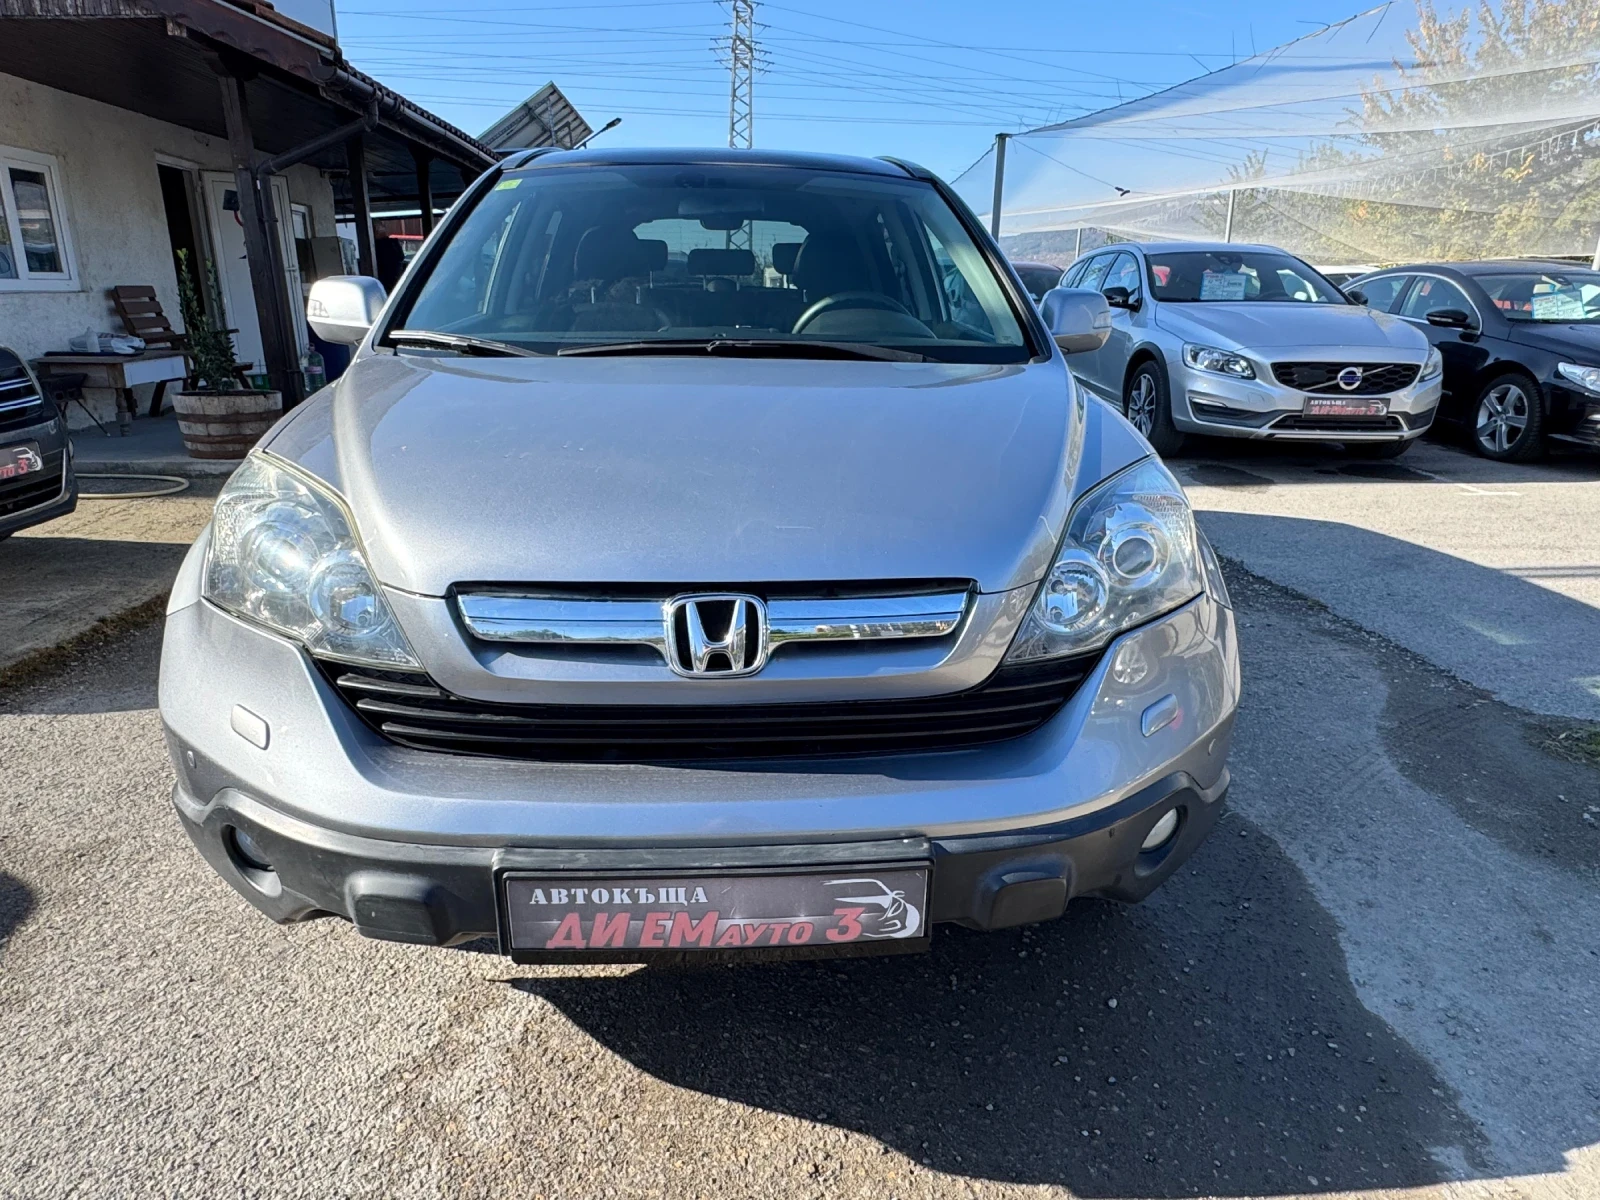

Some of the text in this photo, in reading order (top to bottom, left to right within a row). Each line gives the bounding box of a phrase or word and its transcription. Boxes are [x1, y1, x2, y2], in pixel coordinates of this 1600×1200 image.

[18, 459, 28, 474] 3
[529, 886, 709, 906] АВТОКЪЩА
[545, 911, 631, 949] ДИ
[825, 907, 866, 942] 3
